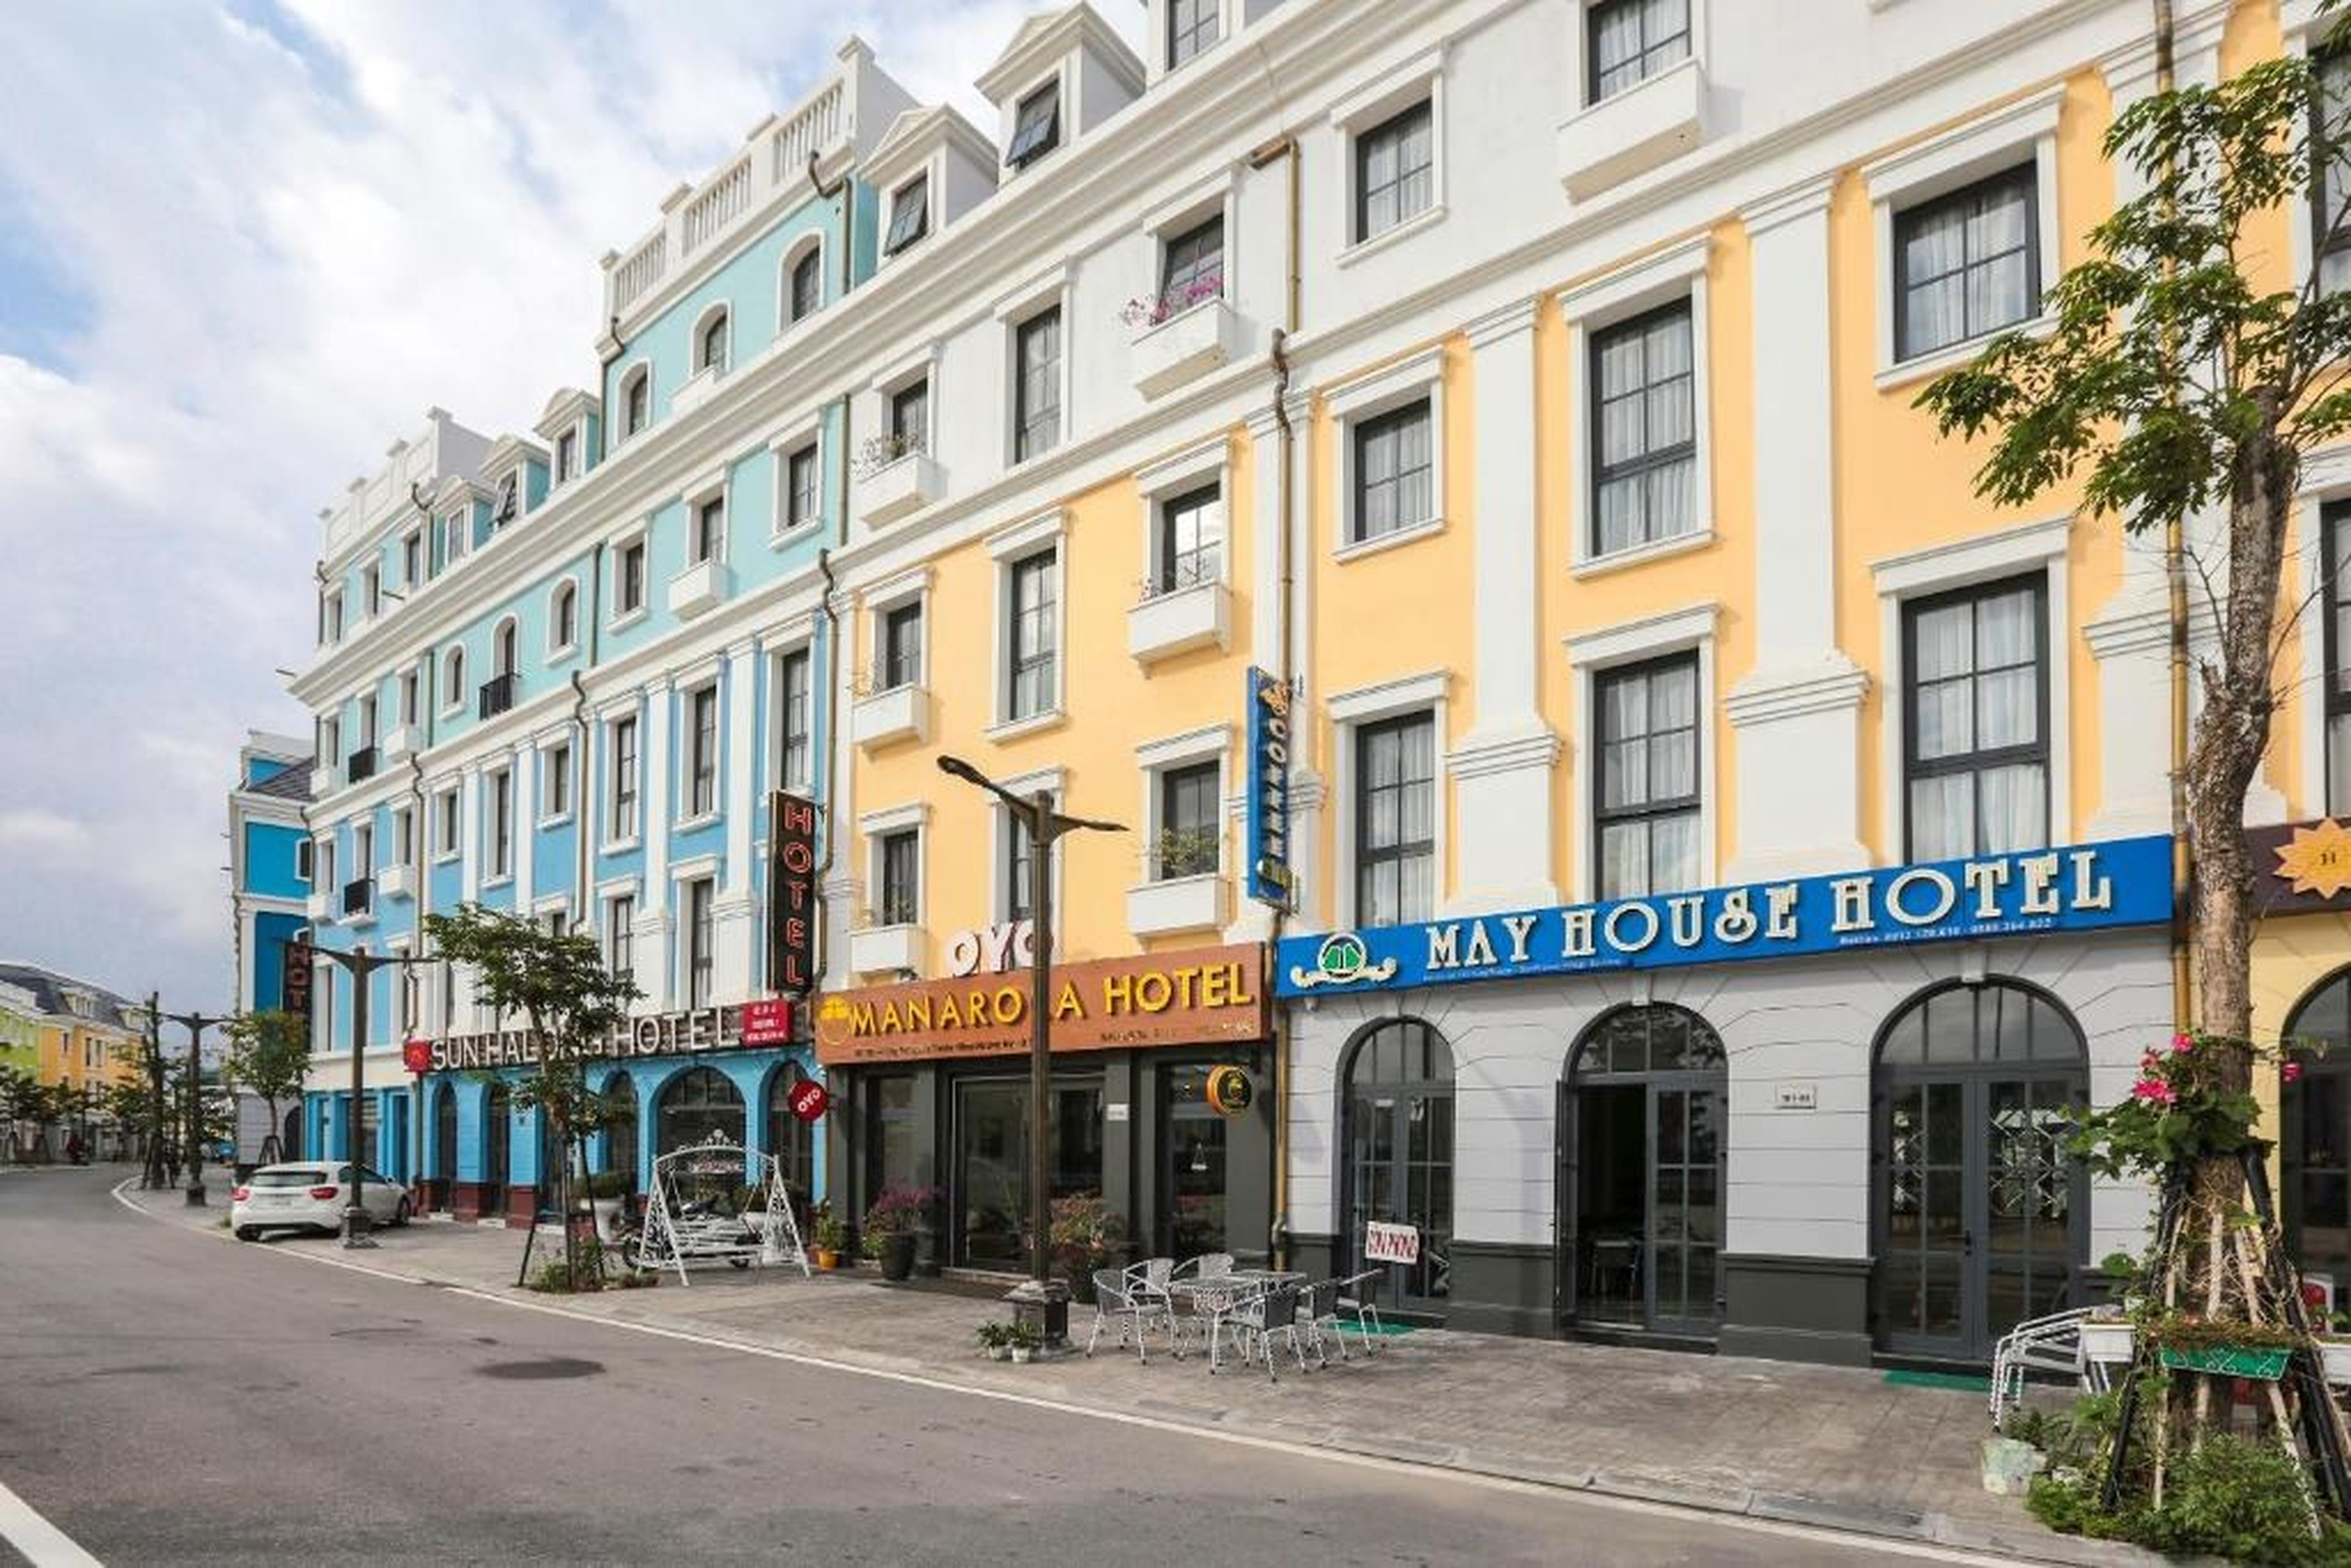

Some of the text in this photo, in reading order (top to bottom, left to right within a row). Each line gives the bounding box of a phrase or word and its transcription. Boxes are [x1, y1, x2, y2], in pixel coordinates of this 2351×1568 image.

[784, 801, 811, 985] HOTEL
[1426, 850, 2112, 971] MAY HOUSE HOTEL
[948, 918, 1054, 978] OYO
[850, 963, 1251, 1036] MANAROA HOTEL
[432, 1035, 479, 1070] SUN
[612, 1005, 740, 1057] HOTEL
[798, 1089, 821, 1112] OYO
